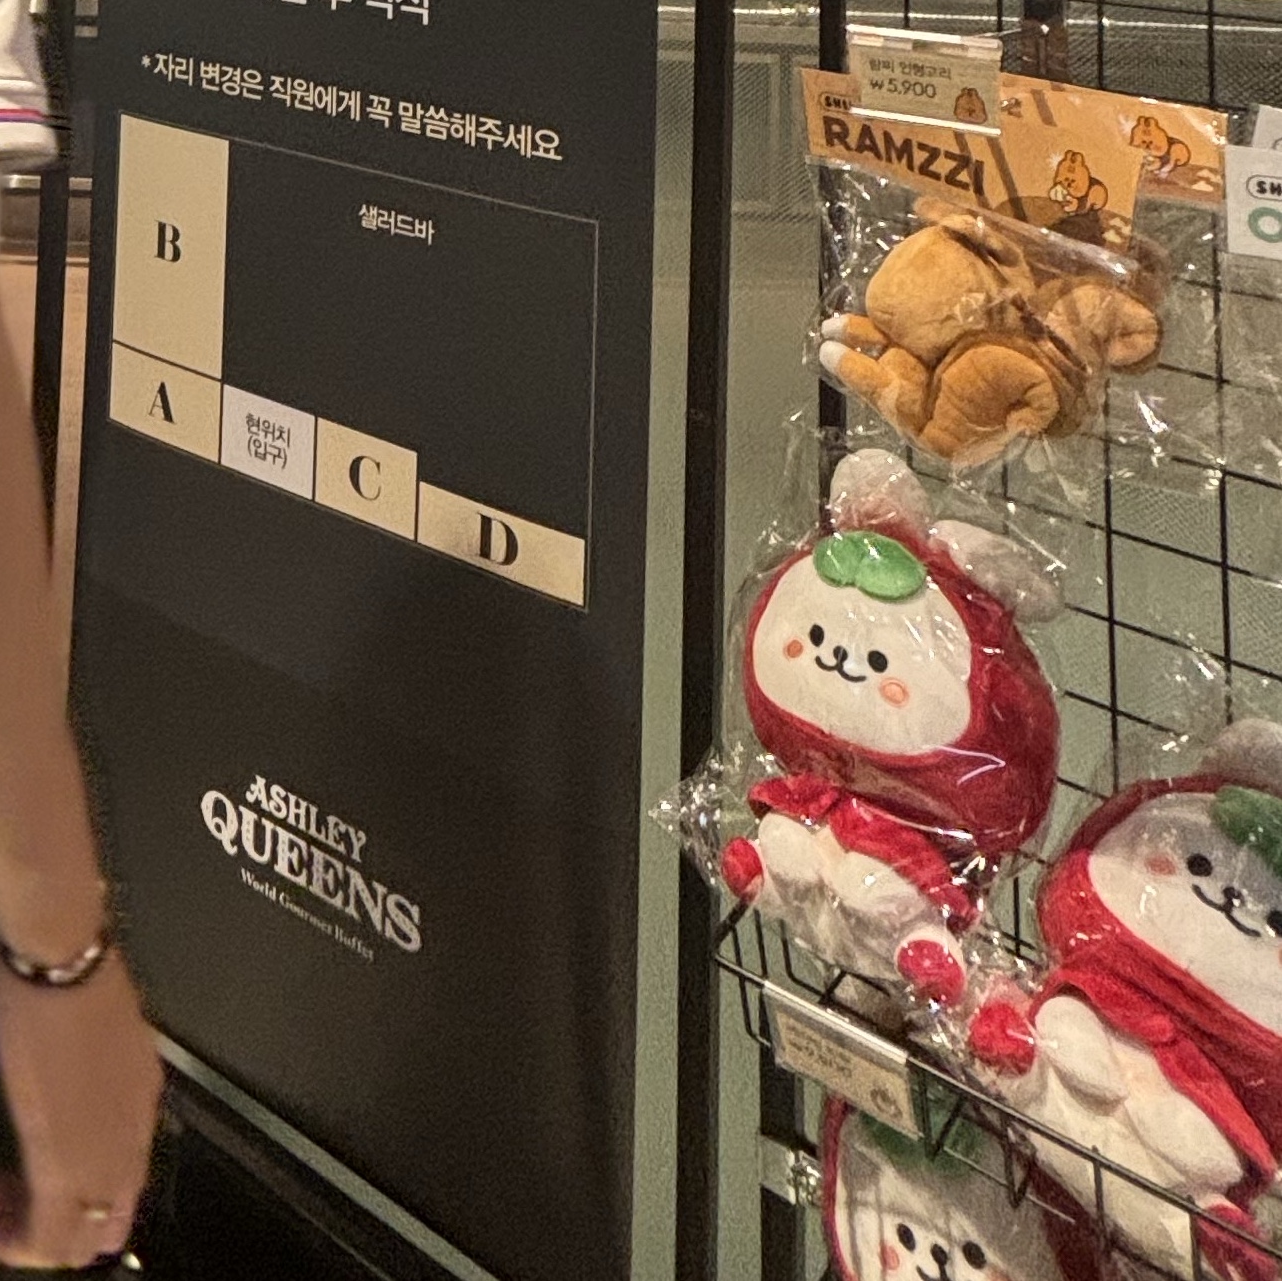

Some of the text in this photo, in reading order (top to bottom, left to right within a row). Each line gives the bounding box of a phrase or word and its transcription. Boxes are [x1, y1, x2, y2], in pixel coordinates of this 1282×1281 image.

[199, 61, 263, 101] 변경은
[269, 74, 361, 121] 직원에게
[365, 95, 393, 127] 꼭
[398, 100, 563, 161] 말씀해주세요
[823, 116, 985, 196] RAMZZI
[155, 220, 182, 263] B
[358, 203, 434, 245] 샐러드바
[148, 381, 176, 424] A
[245, 413, 291, 449] 현위치
[247, 437, 288, 469] (입구)
[348, 455, 381, 501] C
[477, 512, 519, 566] D
[246, 774, 367, 863] ASHLEY
[200, 790, 422, 953] QUEENS
[241, 868, 276, 903] World
